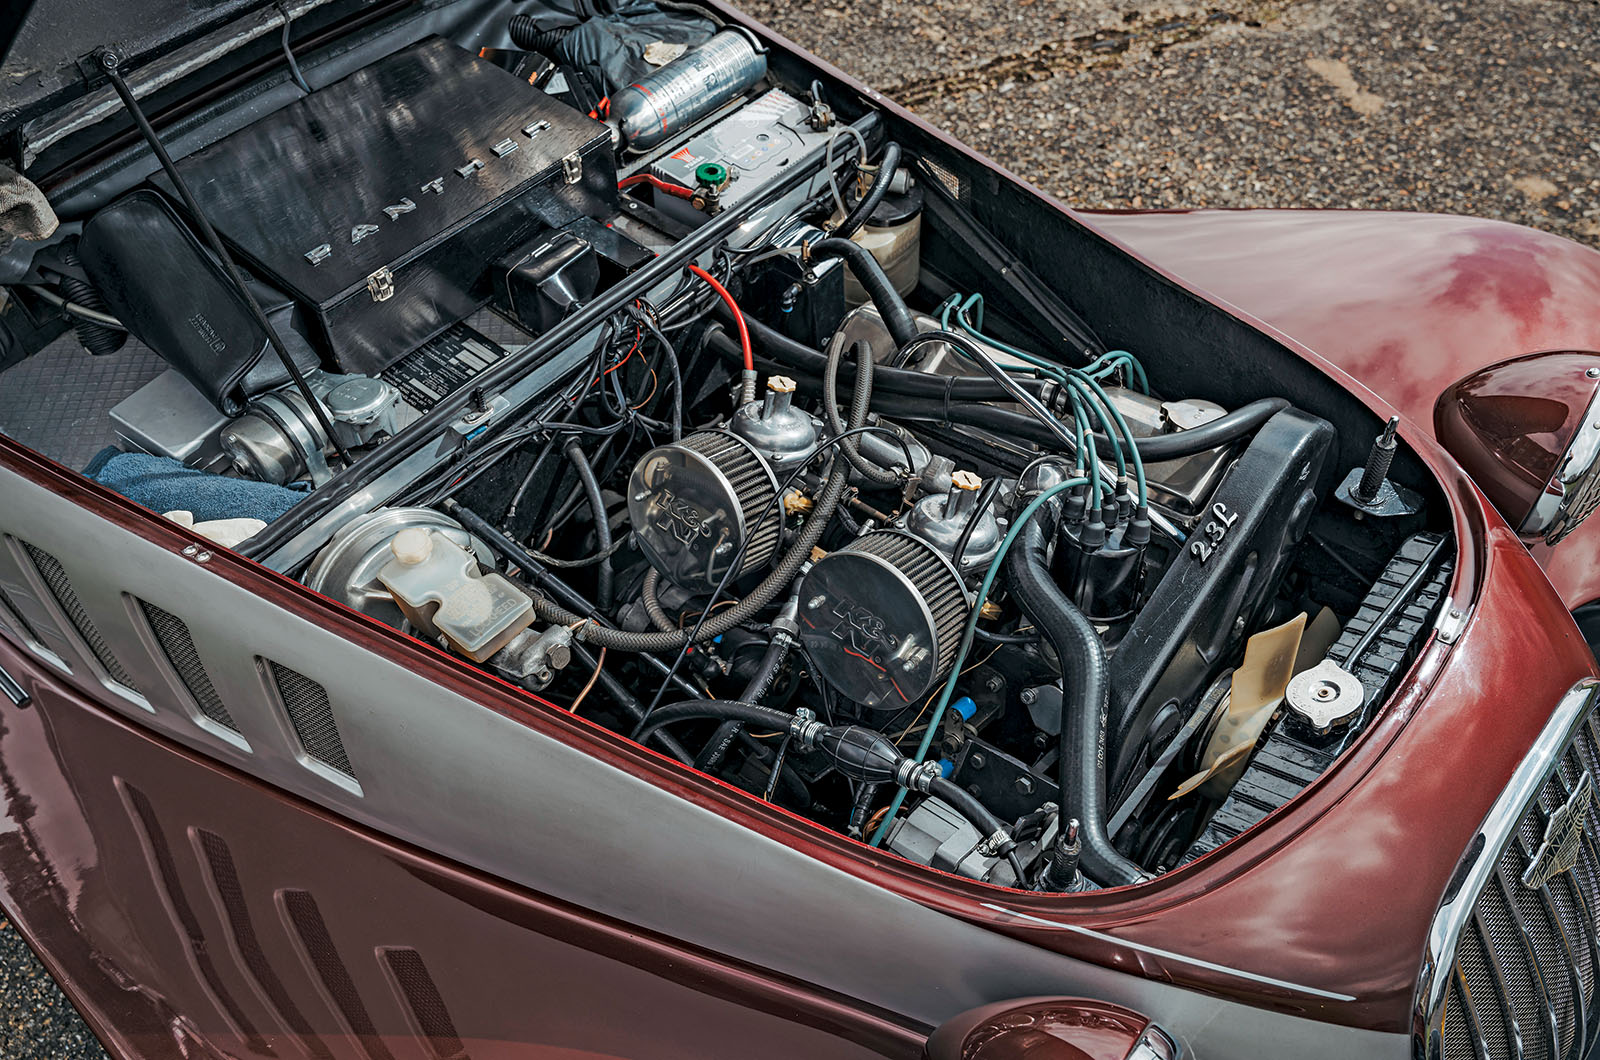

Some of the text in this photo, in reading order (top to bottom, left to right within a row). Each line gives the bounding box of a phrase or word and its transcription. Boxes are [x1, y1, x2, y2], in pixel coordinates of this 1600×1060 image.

[303, 119, 552, 267] PANTHER
[656, 489, 711, 547] K&N
[1190, 502, 1239, 562] 2.3L
[831, 598, 898, 658] K&N
[1536, 793, 1587, 879] PANTHER
